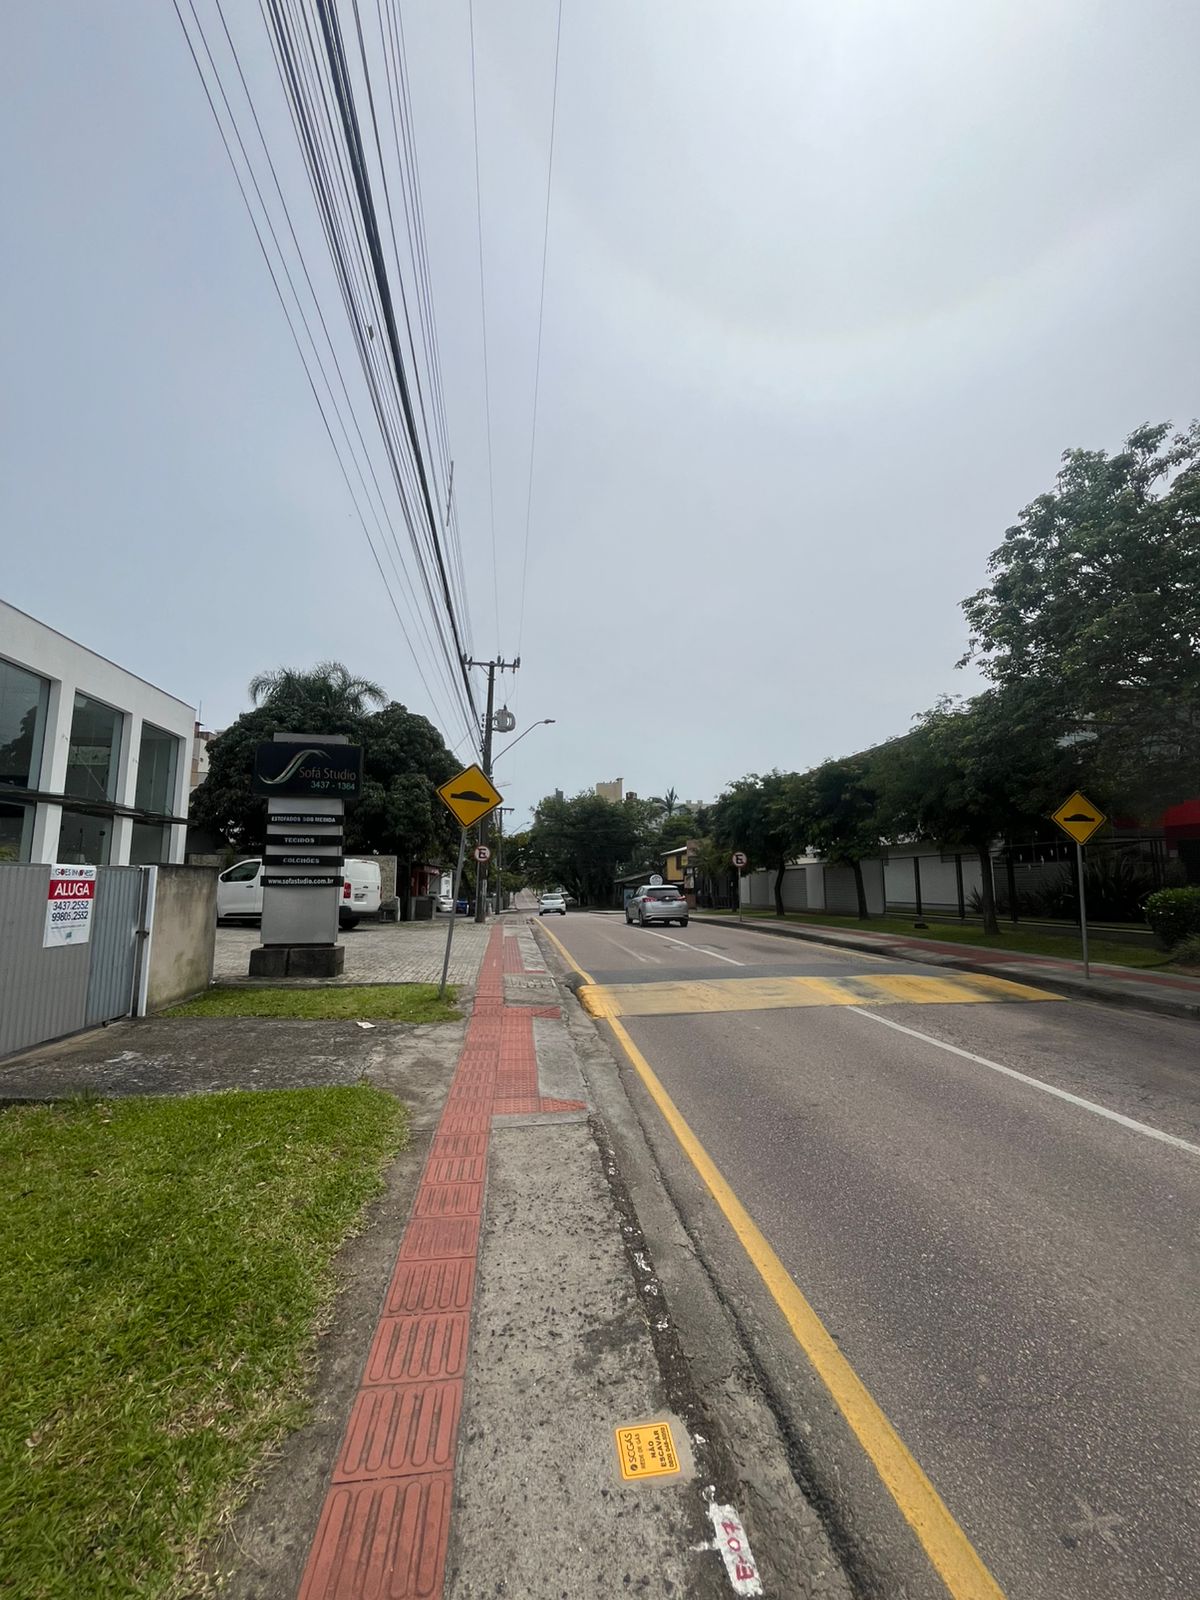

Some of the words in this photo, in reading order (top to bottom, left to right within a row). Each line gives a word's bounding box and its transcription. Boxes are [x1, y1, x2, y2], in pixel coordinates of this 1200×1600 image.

[299, 766, 321, 779] Sofá
[324, 767, 357, 781] Studio
[310, 781, 330, 789] 3437
[268, 877, 334, 885] www.sofastudio.com.br
[54, 882, 90, 896] ALUGA
[53, 901, 89, 911] 3437.2552
[648, 1441, 656, 1458] NÃO
[654, 1430, 666, 1467] ESCAVAR
